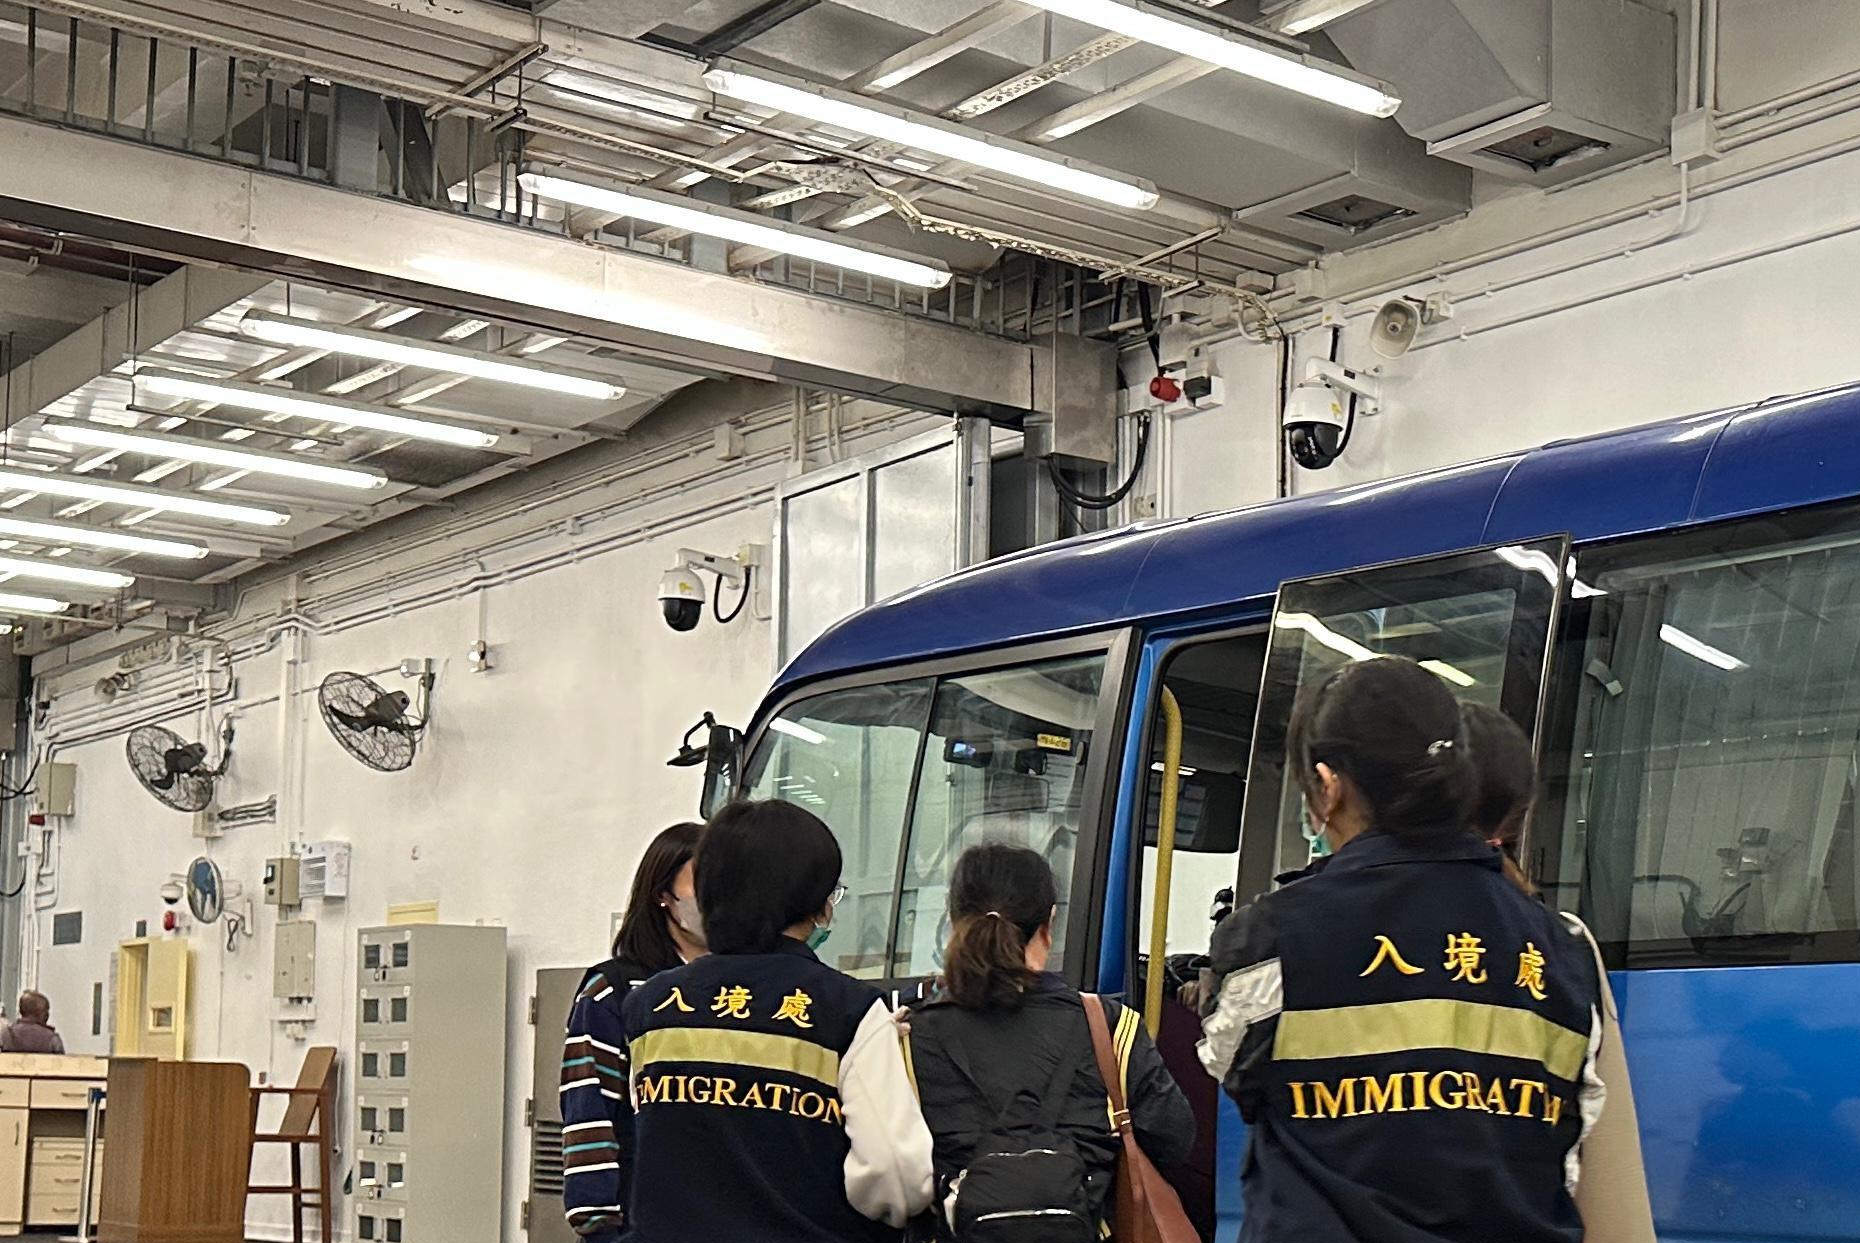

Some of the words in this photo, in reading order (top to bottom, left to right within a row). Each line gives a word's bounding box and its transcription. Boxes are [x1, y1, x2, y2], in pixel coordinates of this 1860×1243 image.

[1359, 932, 1548, 1000] 入境處
[653, 986, 813, 1028] 入境處
[637, 1075, 842, 1125] MIGRATION
